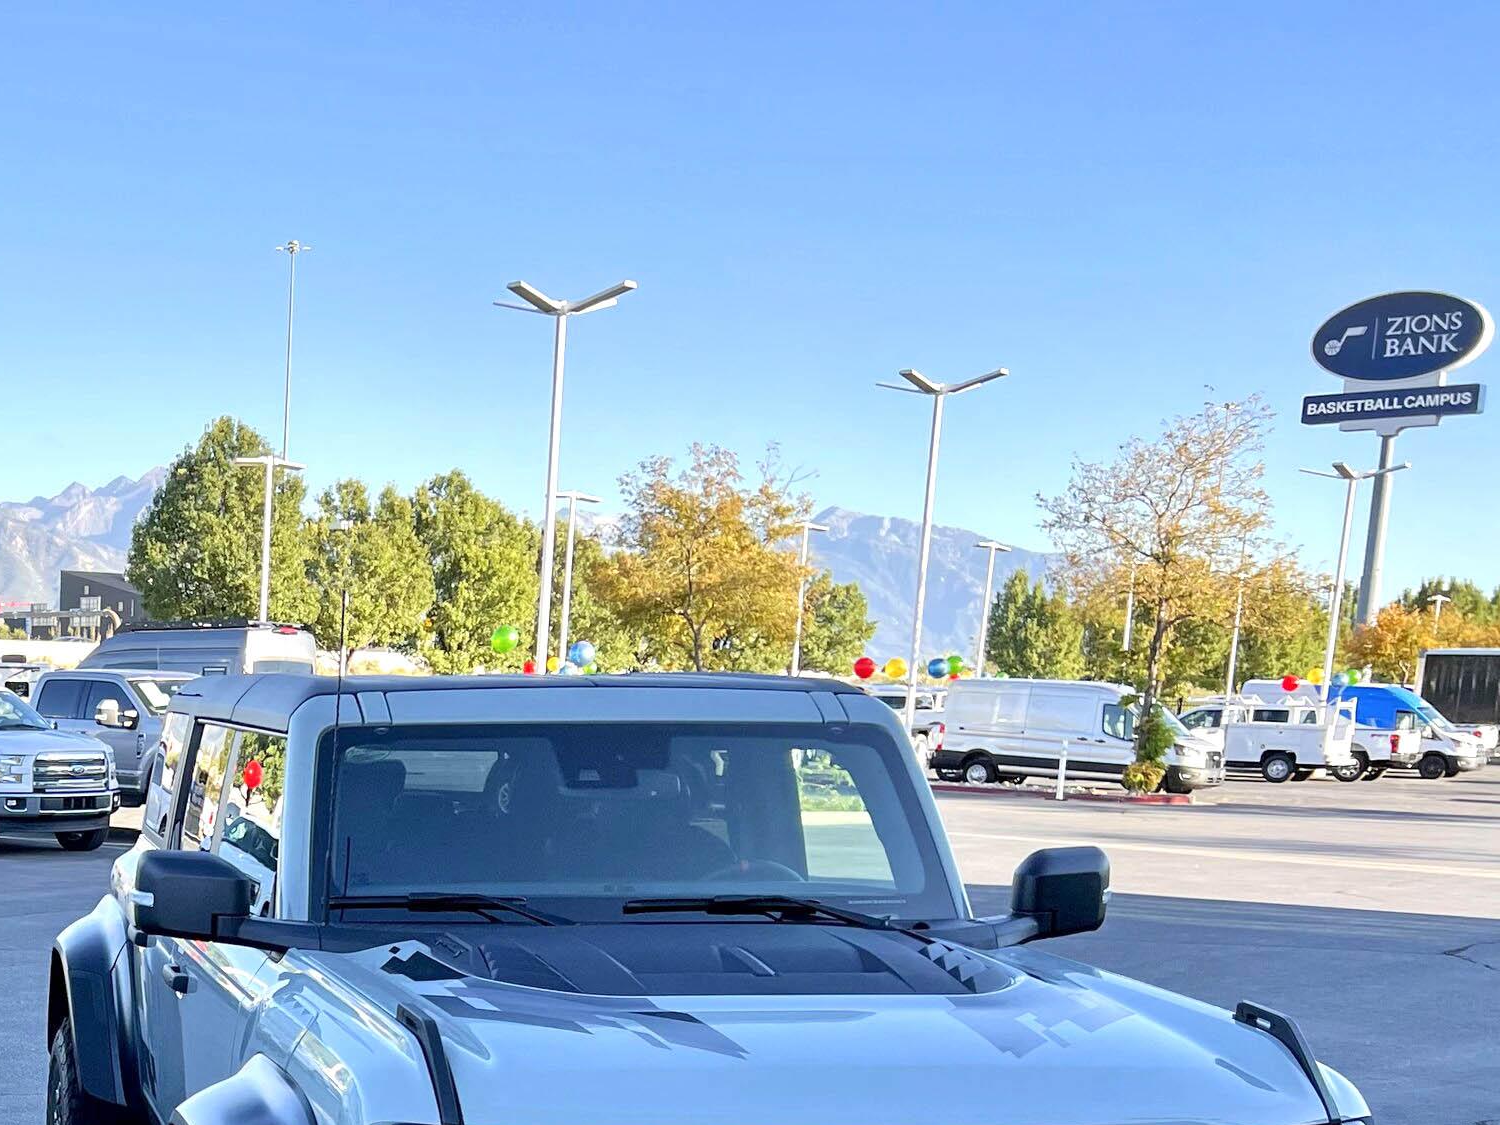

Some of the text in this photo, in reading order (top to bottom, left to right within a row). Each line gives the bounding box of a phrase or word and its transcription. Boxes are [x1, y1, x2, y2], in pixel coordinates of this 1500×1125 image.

[1385, 311, 1463, 336] ZIONS
[1383, 332, 1460, 358] BANK
[1306, 391, 1472, 416] BASKETBALL CAMPUS
